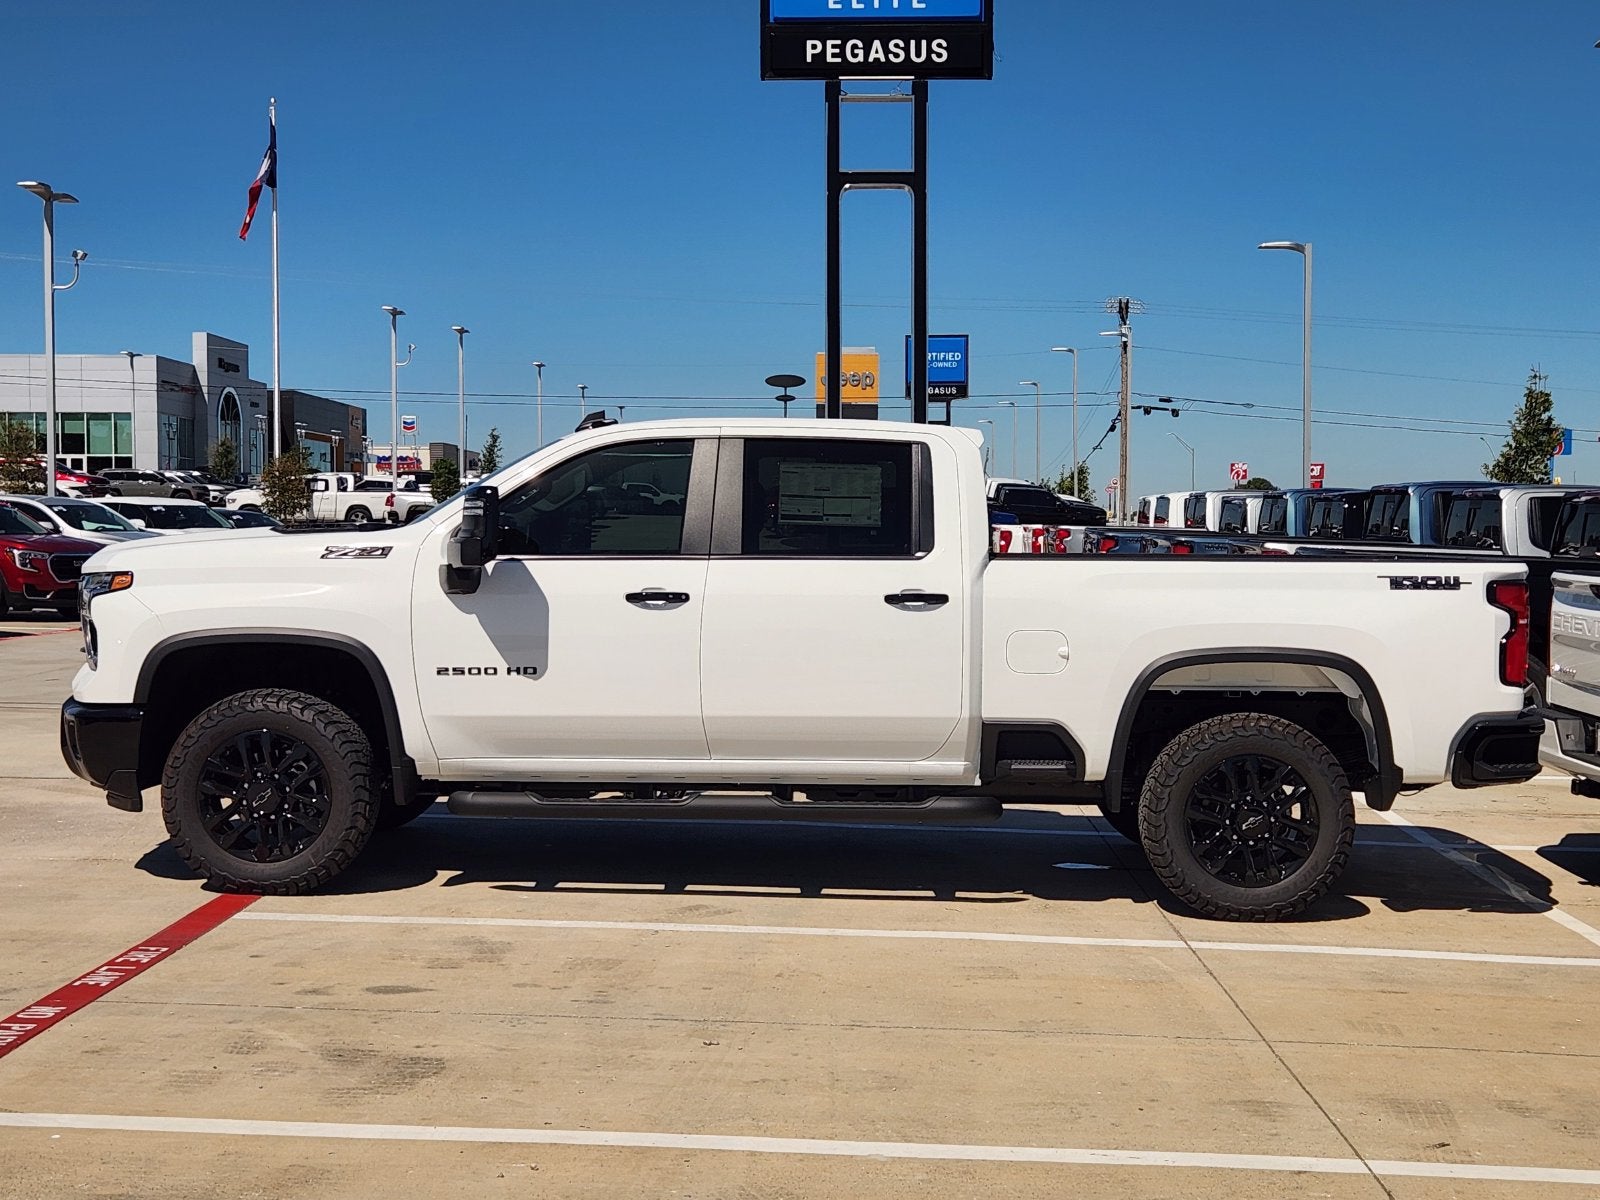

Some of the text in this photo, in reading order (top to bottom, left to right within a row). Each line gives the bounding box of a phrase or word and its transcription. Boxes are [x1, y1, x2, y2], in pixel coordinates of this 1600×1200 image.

[806, 39, 948, 63] PEGASUS
[928, 352, 961, 361] RTIFIED
[928, 386, 957, 395] GASUS
[436, 666, 538, 676] 2500 HD
[72, 946, 170, 987] FIRE LANE
[16, 1006, 67, 1018] NO
